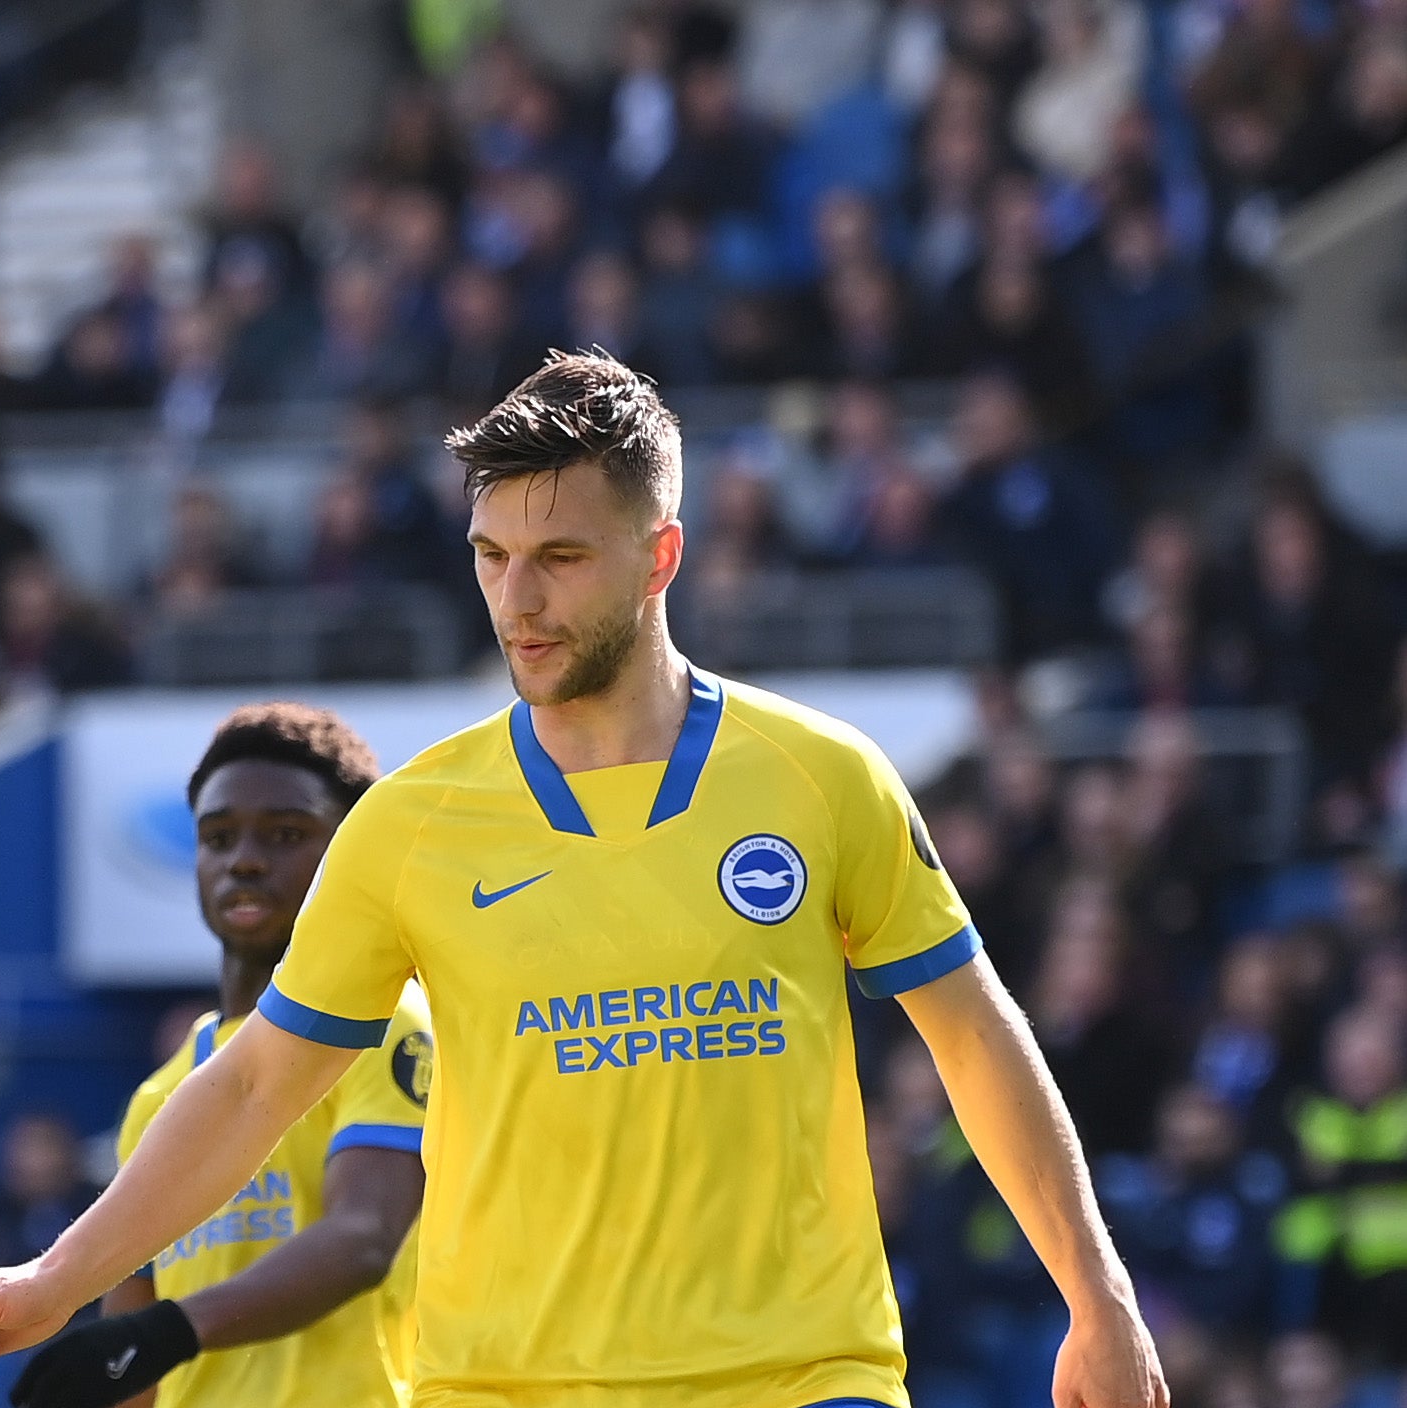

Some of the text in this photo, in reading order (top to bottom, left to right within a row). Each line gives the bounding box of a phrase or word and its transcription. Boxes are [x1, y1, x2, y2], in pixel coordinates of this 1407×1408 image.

[749, 908, 781, 918] ALBION
[515, 977, 779, 1036] AMERICAN
[554, 1019, 785, 1074] EXPRESS
